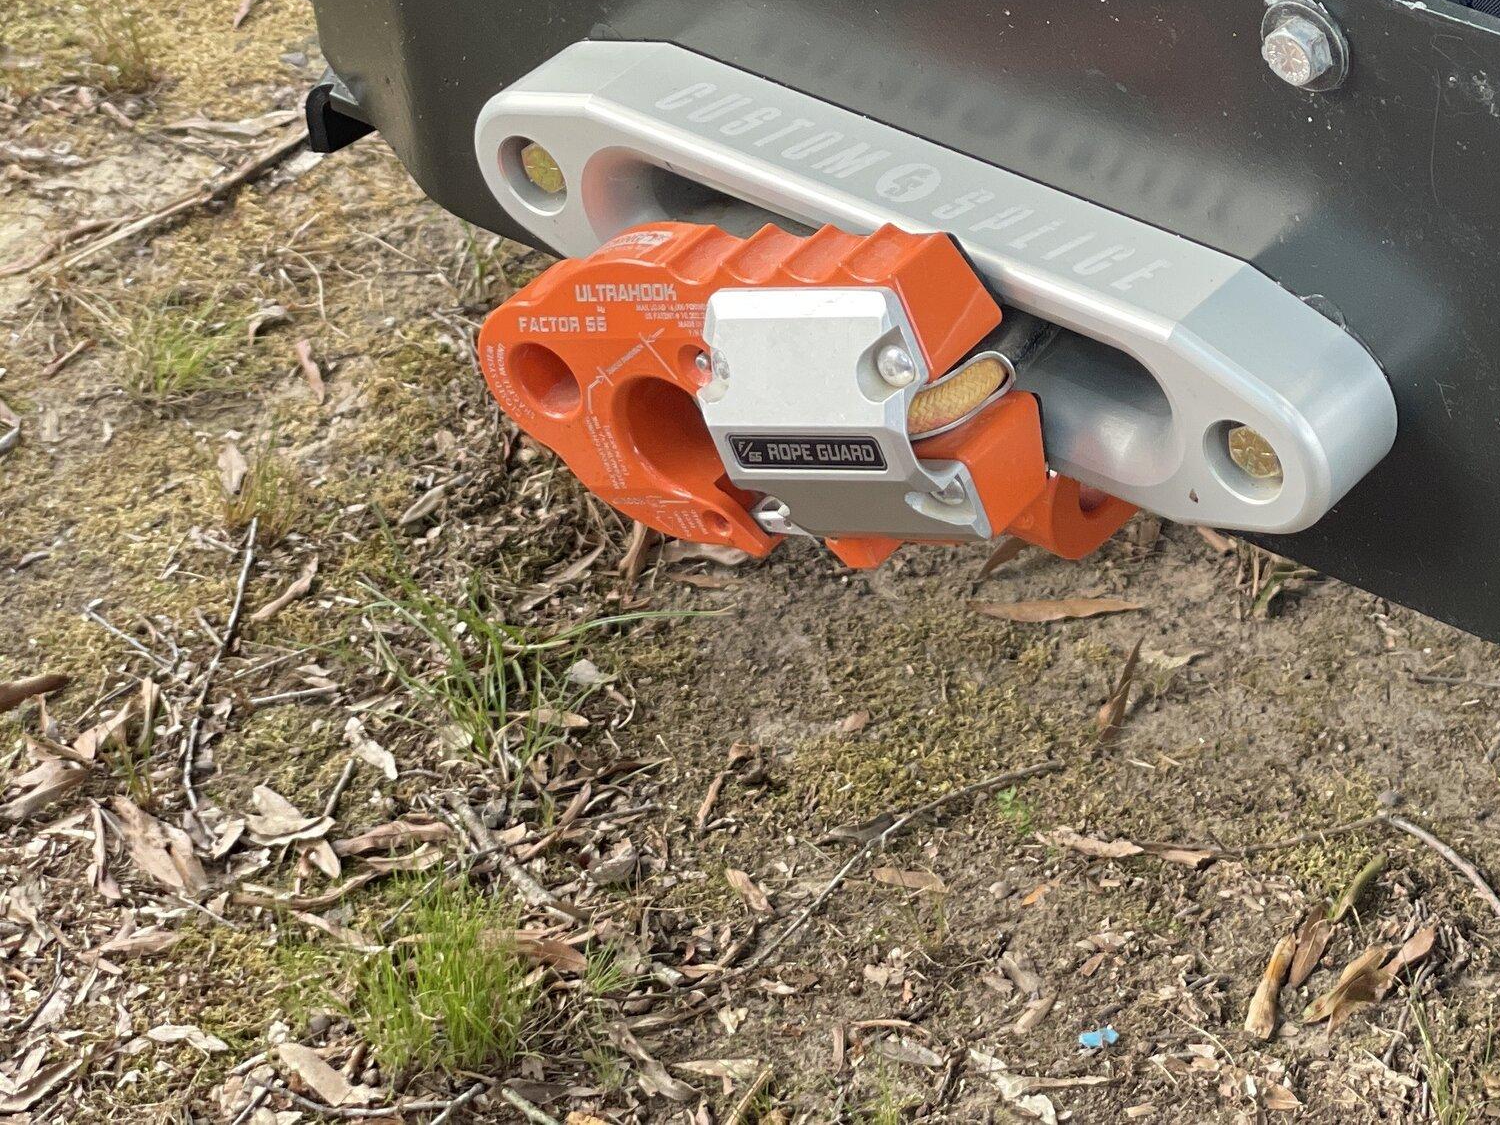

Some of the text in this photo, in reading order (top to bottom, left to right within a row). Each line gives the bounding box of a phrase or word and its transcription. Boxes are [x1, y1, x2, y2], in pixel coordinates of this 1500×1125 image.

[655, 82, 1172, 290] CUSTOM SPLICE
[575, 283, 677, 302] ULTRAHOOK
[518, 316, 580, 332] FACTOR
[767, 443, 814, 461] ROPE
[816, 444, 875, 462] GUARD
